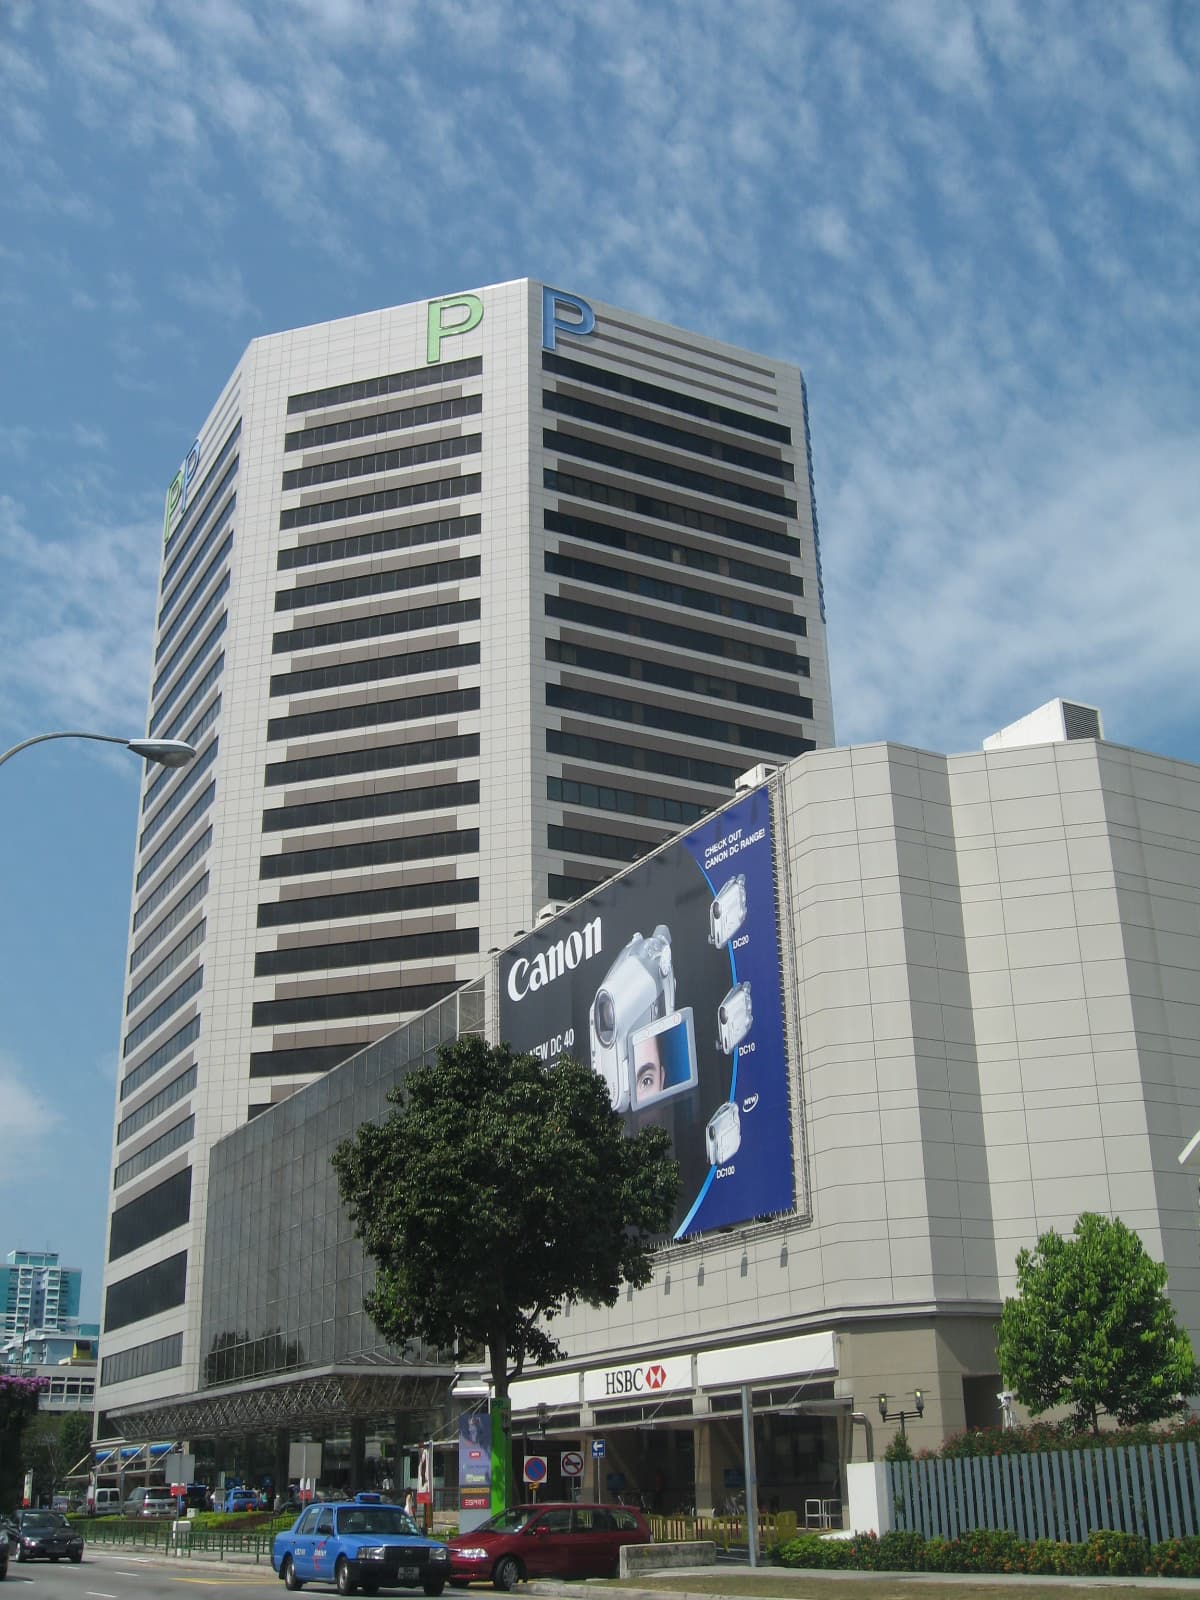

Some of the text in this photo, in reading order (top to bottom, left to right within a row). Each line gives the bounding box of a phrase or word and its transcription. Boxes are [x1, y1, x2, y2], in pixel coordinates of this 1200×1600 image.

[426, 293, 484, 364] P
[542, 285, 596, 351] P
[704, 828, 743, 858] CHECK OUT
[704, 827, 766, 870] CANON DC RANGE!
[732, 934, 750, 950] DC20
[507, 916, 602, 1002] Canon
[550, 1037, 562, 1057] DC
[563, 1028, 575, 1048] 40
[738, 1042, 756, 1057] DC10
[716, 1165, 736, 1179] DC100
[605, 1367, 644, 1395] HSBC
